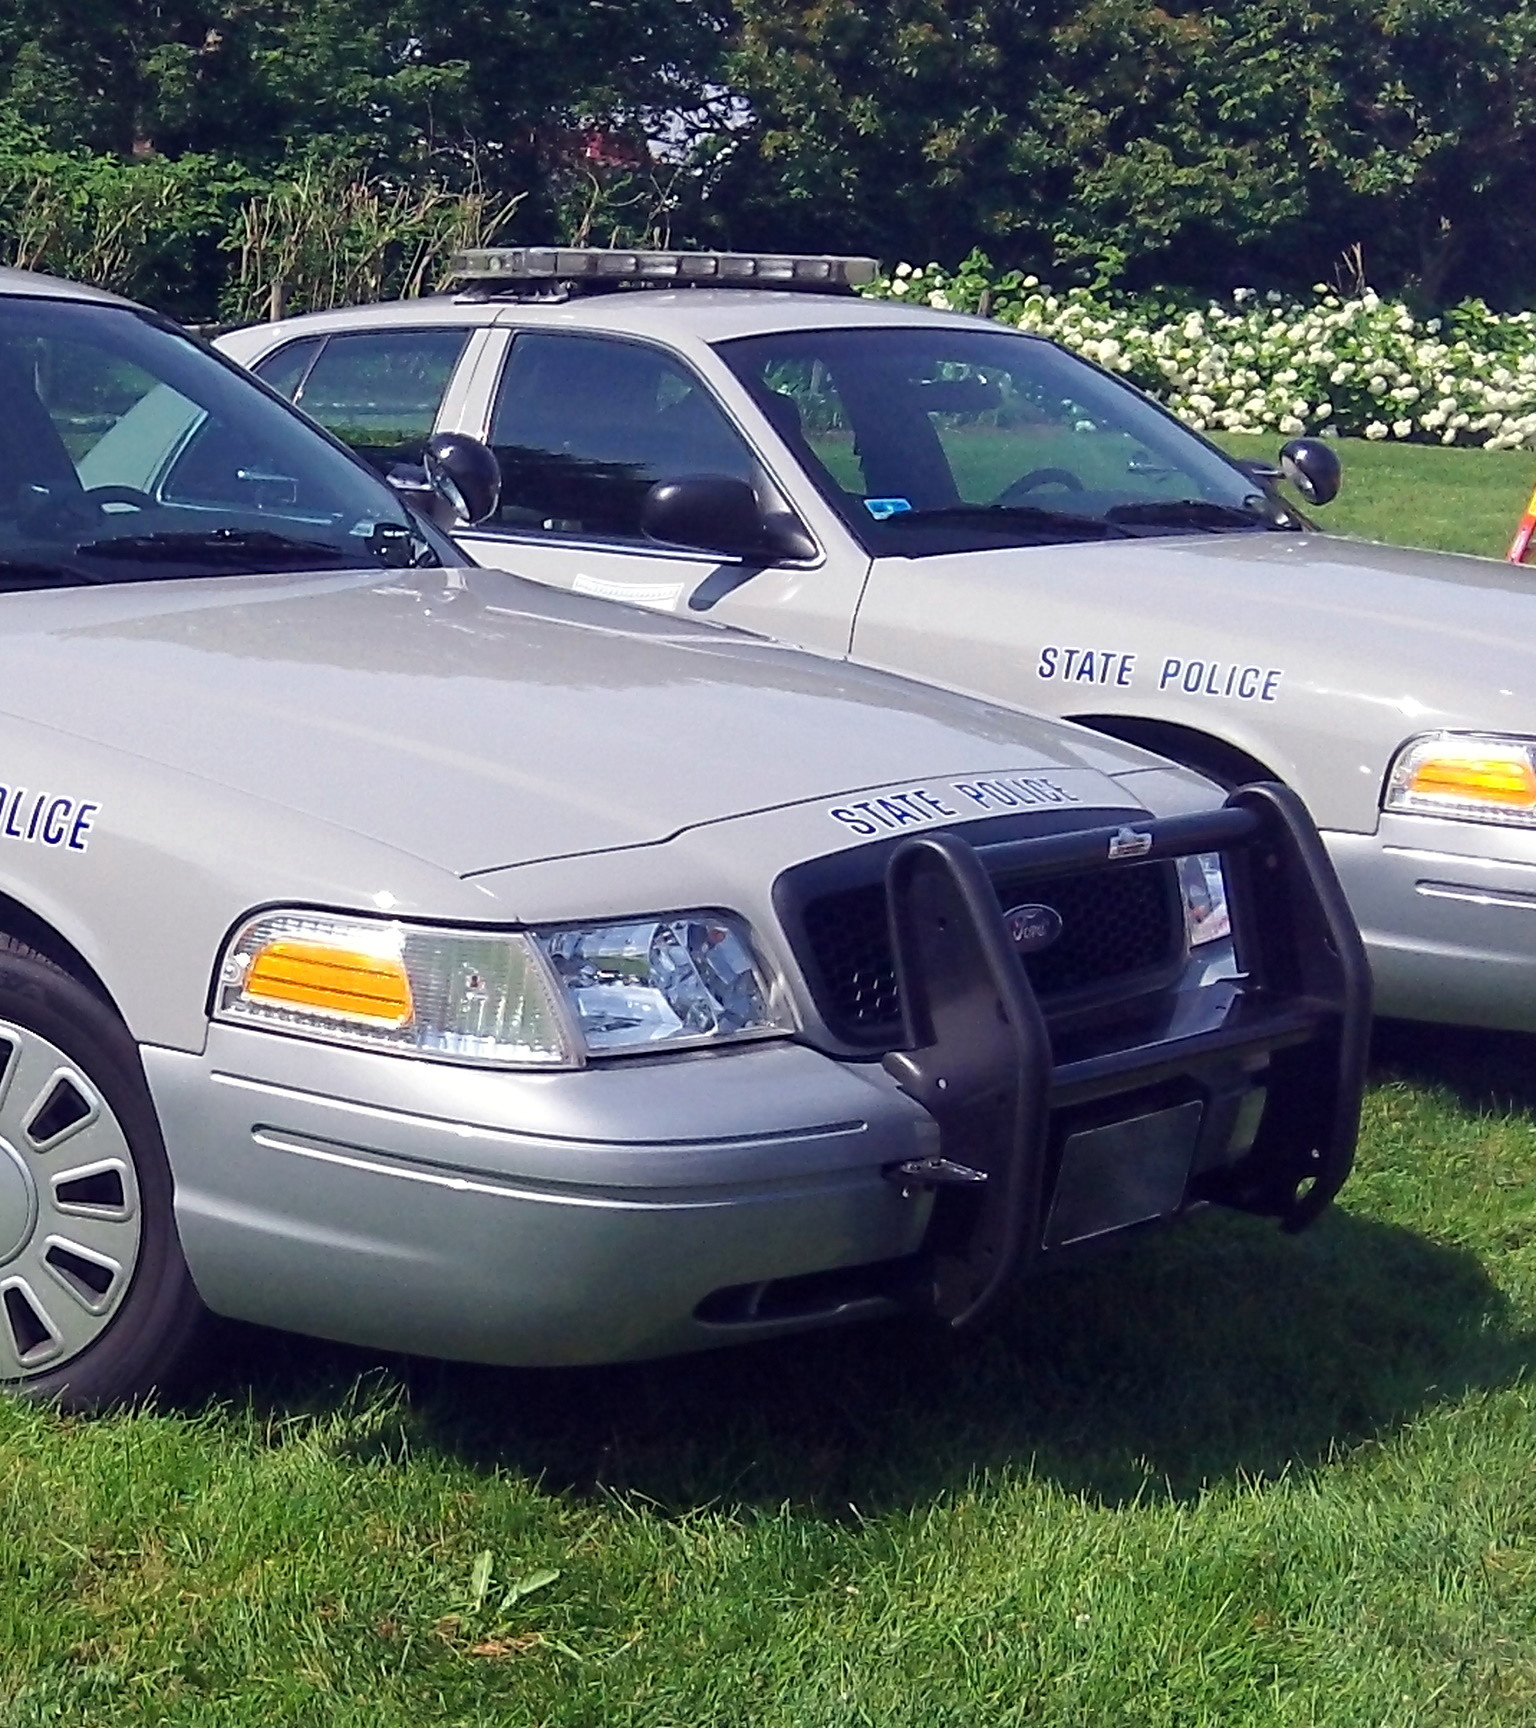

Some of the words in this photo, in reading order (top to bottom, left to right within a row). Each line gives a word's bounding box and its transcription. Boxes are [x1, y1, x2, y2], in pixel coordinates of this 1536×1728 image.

[1037, 645, 1137, 687] STATE
[1158, 657, 1283, 702] POLICE
[828, 788, 959, 836] STATE
[953, 777, 1082, 810] POLICE
